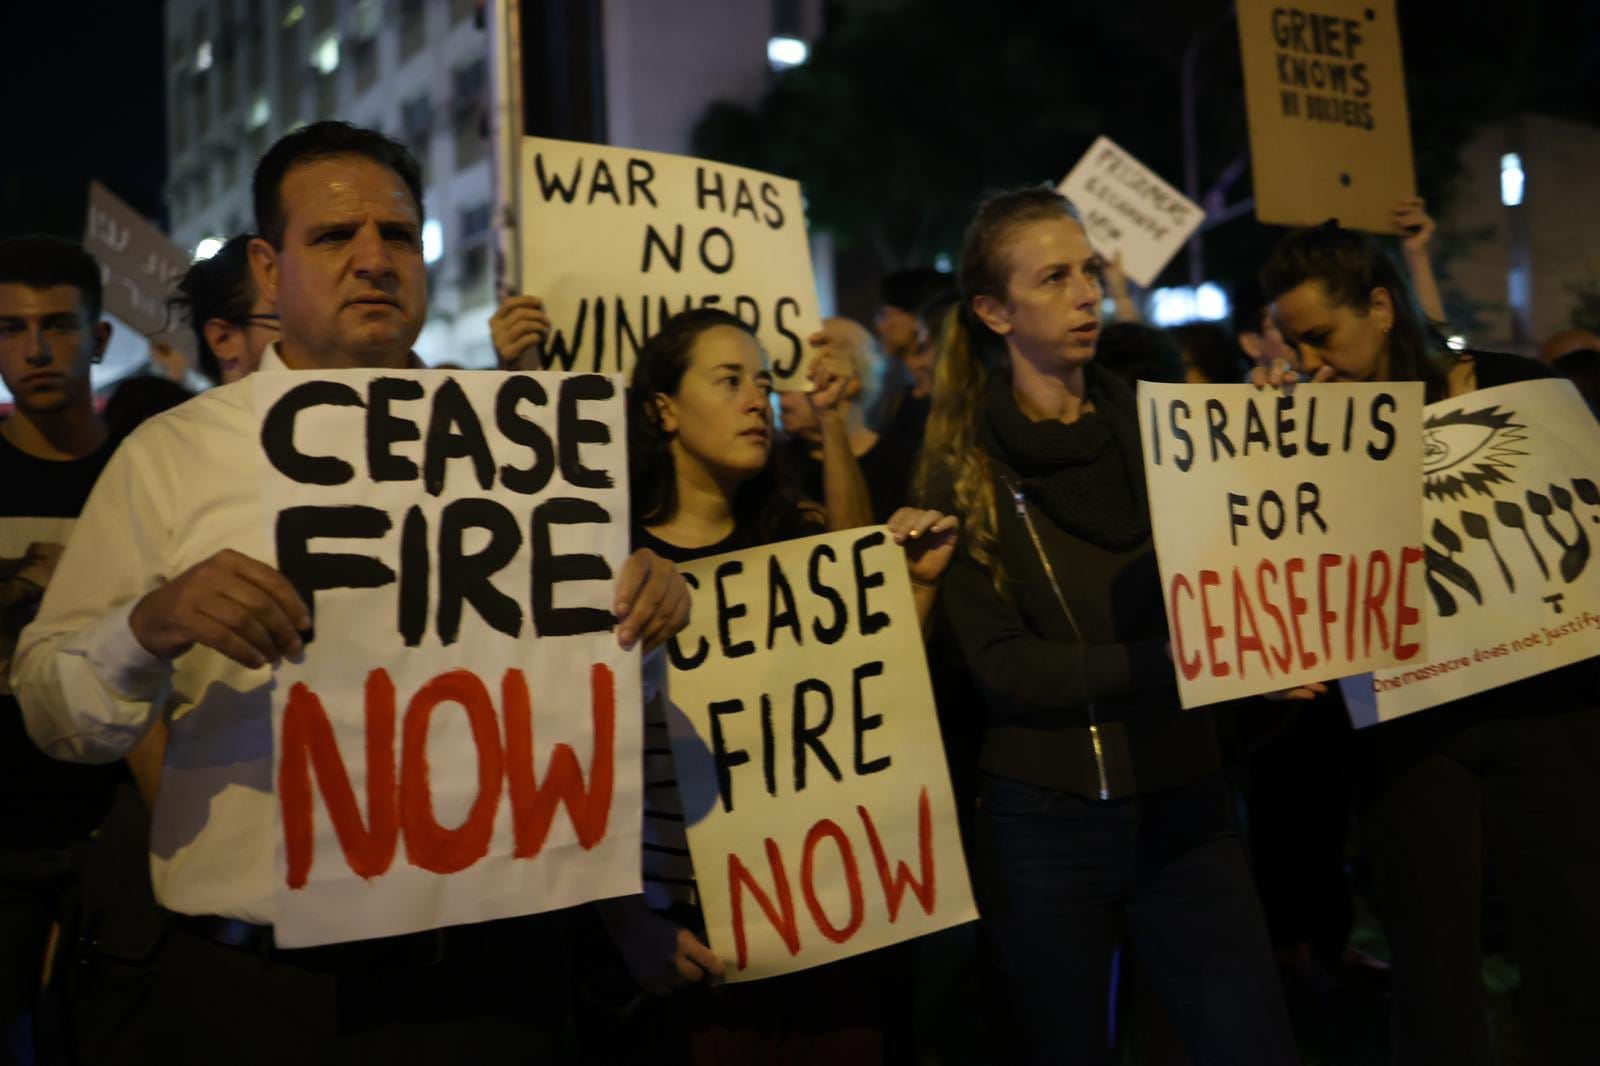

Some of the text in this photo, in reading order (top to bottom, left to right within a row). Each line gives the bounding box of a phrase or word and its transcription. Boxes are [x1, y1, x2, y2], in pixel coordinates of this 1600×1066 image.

[1271, 8, 1362, 60] GRIEF
[1277, 53, 1370, 98] KNOWS
[535, 153, 785, 229] WAR HAS
[641, 223, 734, 274] NO
[539, 295, 802, 379] WINS
[261, 374, 615, 496] CEASE
[1150, 393, 1396, 472] ISRAELIS
[1227, 482, 1328, 546] FOR
[276, 497, 619, 647] FIRE
[667, 531, 891, 670] CEASE
[1170, 546, 1424, 681] CEASEFIRE
[1372, 675, 1402, 692] One
[1402, 655, 1470, 684] massacre
[1473, 643, 1510, 662] does
[1512, 632, 1542, 652] not
[279, 662, 615, 890] NOW
[709, 661, 891, 813] FIRE
[727, 785, 936, 971] NOW
